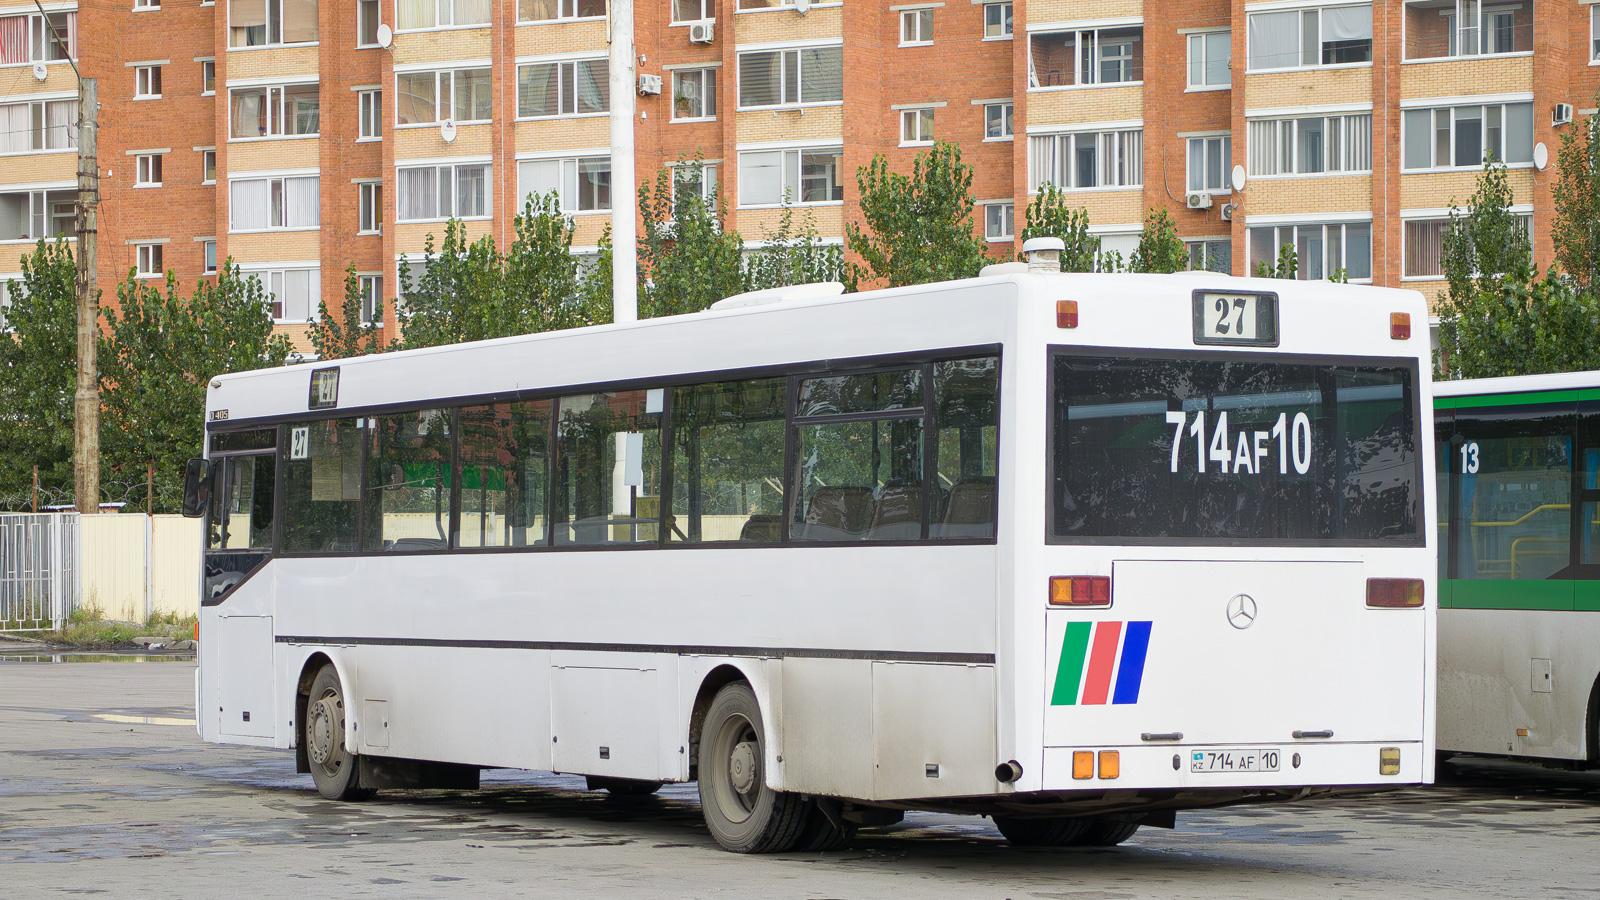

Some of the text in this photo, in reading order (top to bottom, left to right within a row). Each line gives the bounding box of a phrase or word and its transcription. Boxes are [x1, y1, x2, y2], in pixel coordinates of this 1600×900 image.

[1215, 297, 1247, 335] 27
[215, 410, 228, 420] 405
[294, 430, 306, 457] 27
[1460, 442, 1480, 474] 13
[1208, 752, 1233, 770] 714
[1238, 756, 1254, 769] AF
[1262, 752, 1278, 768] 10
